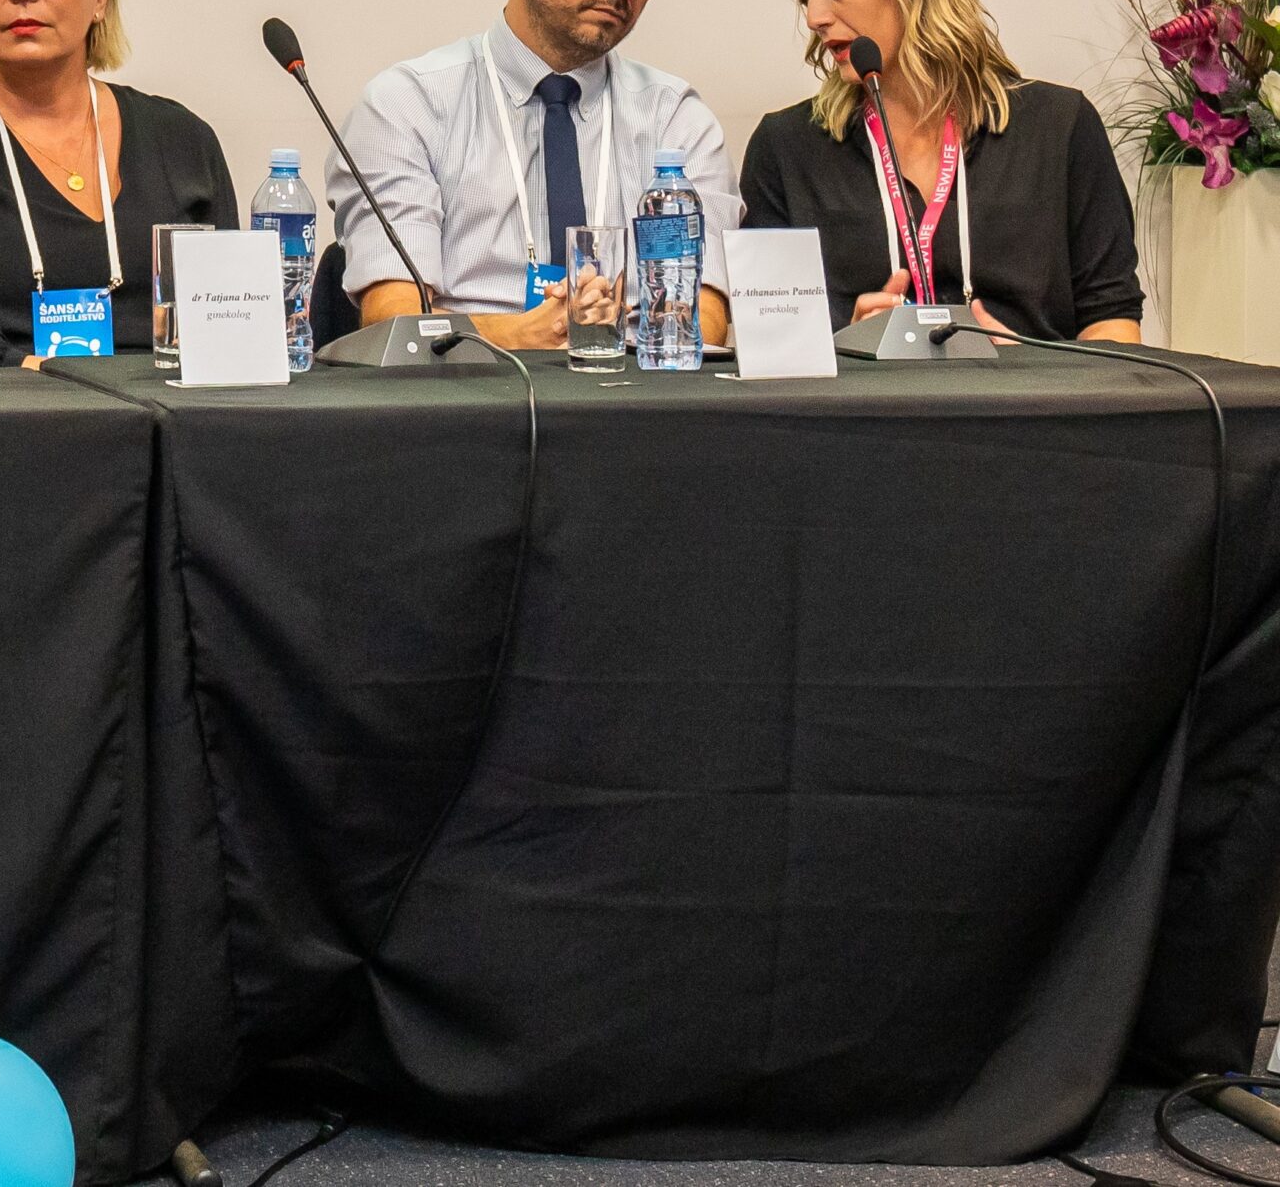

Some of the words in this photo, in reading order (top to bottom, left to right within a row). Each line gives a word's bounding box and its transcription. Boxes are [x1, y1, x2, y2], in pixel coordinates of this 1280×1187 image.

[933, 144, 957, 203] NEWLIFE
[191, 293, 202, 302] dr
[205, 293, 240, 303] Tatjana
[243, 293, 271, 302] Dosev
[732, 288, 742, 298] dr
[744, 287, 790, 297] Athanasios
[792, 286, 825, 296] Pantelis
[39, 303, 83, 316] ŠANSA
[87, 302, 105, 313] ZA
[206, 309, 251, 321] ginekolog
[759, 304, 799, 316] ginekolog
[40, 313, 106, 324] RODITELJSTVO
